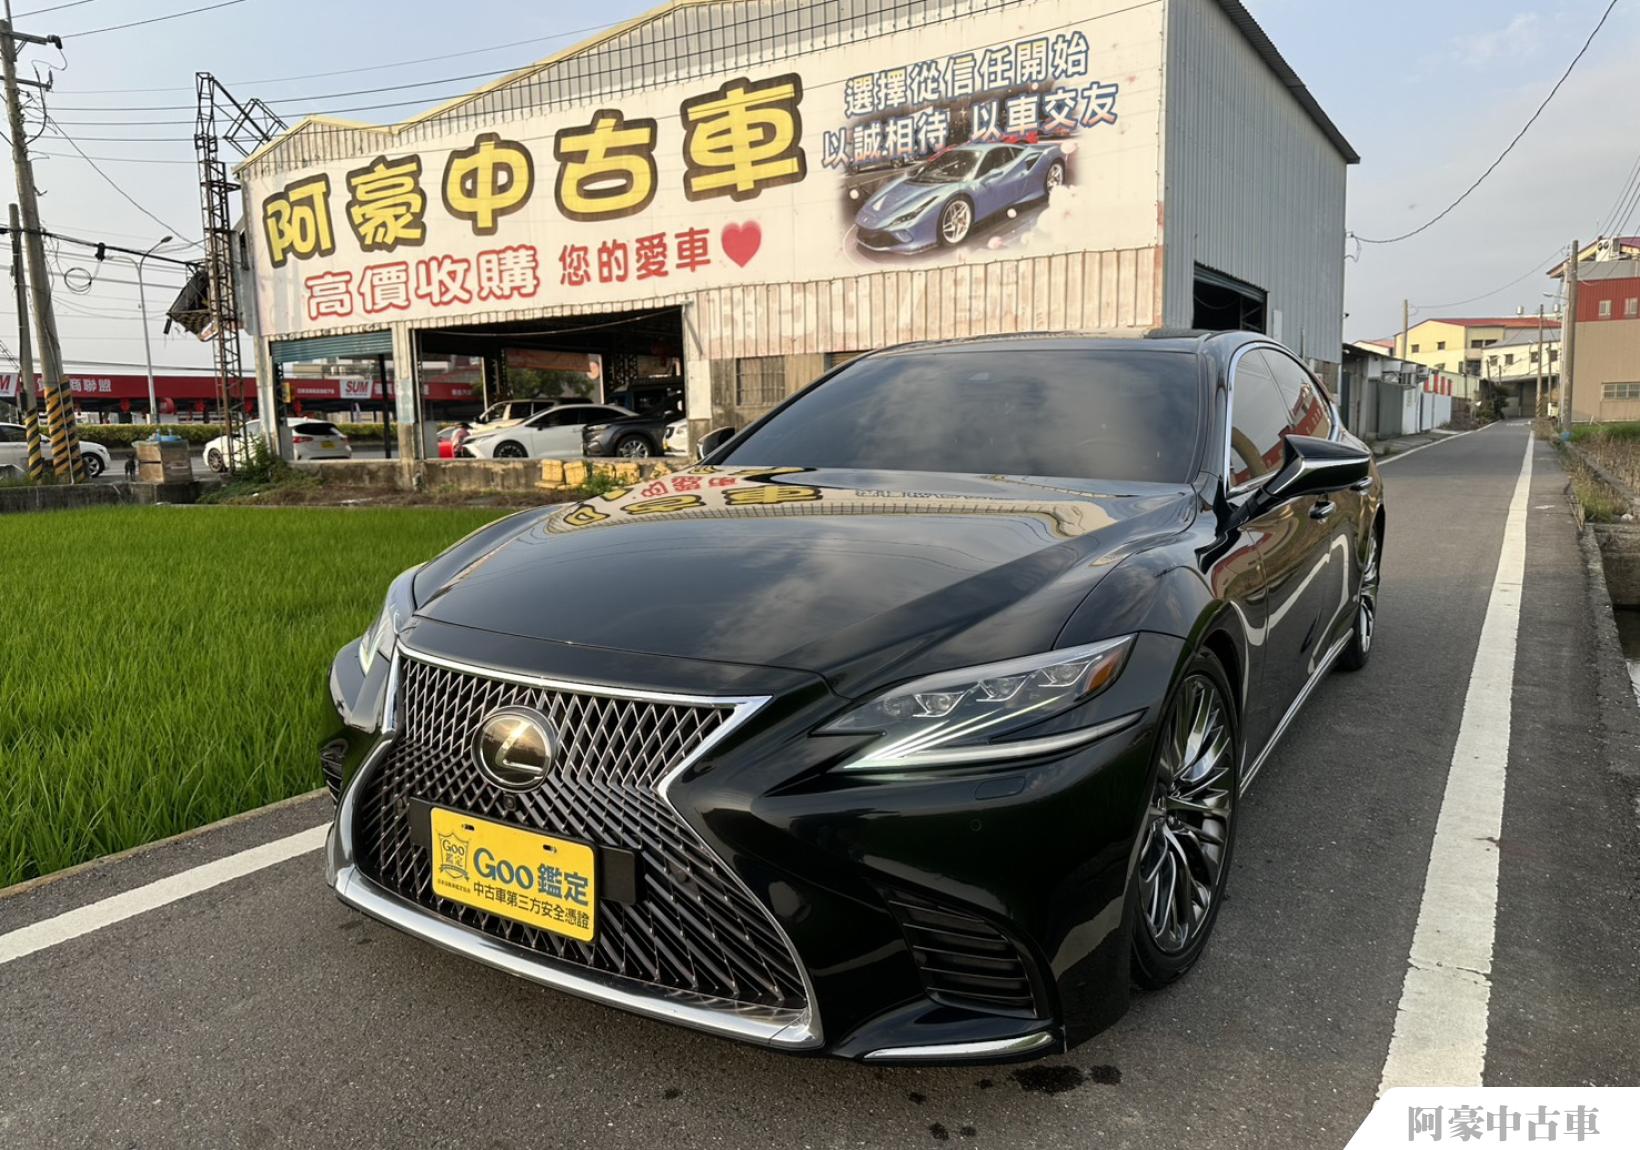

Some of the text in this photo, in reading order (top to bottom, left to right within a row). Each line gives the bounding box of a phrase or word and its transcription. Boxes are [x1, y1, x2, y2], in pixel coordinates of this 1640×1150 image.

[844, 31, 1089, 117] 選擇從信任開始
[822, 81, 1118, 169] 以誠相待 以車交友
[263, 72, 807, 268] 阿豪中古車
[305, 227, 711, 320] 高價收購 您的愛車
[345, 381, 369, 393] SUM
[442, 839, 465, 856] Goo
[473, 847, 589, 907] Goo 鑑定
[473, 881, 590, 930] 中古車第三方安全憑證
